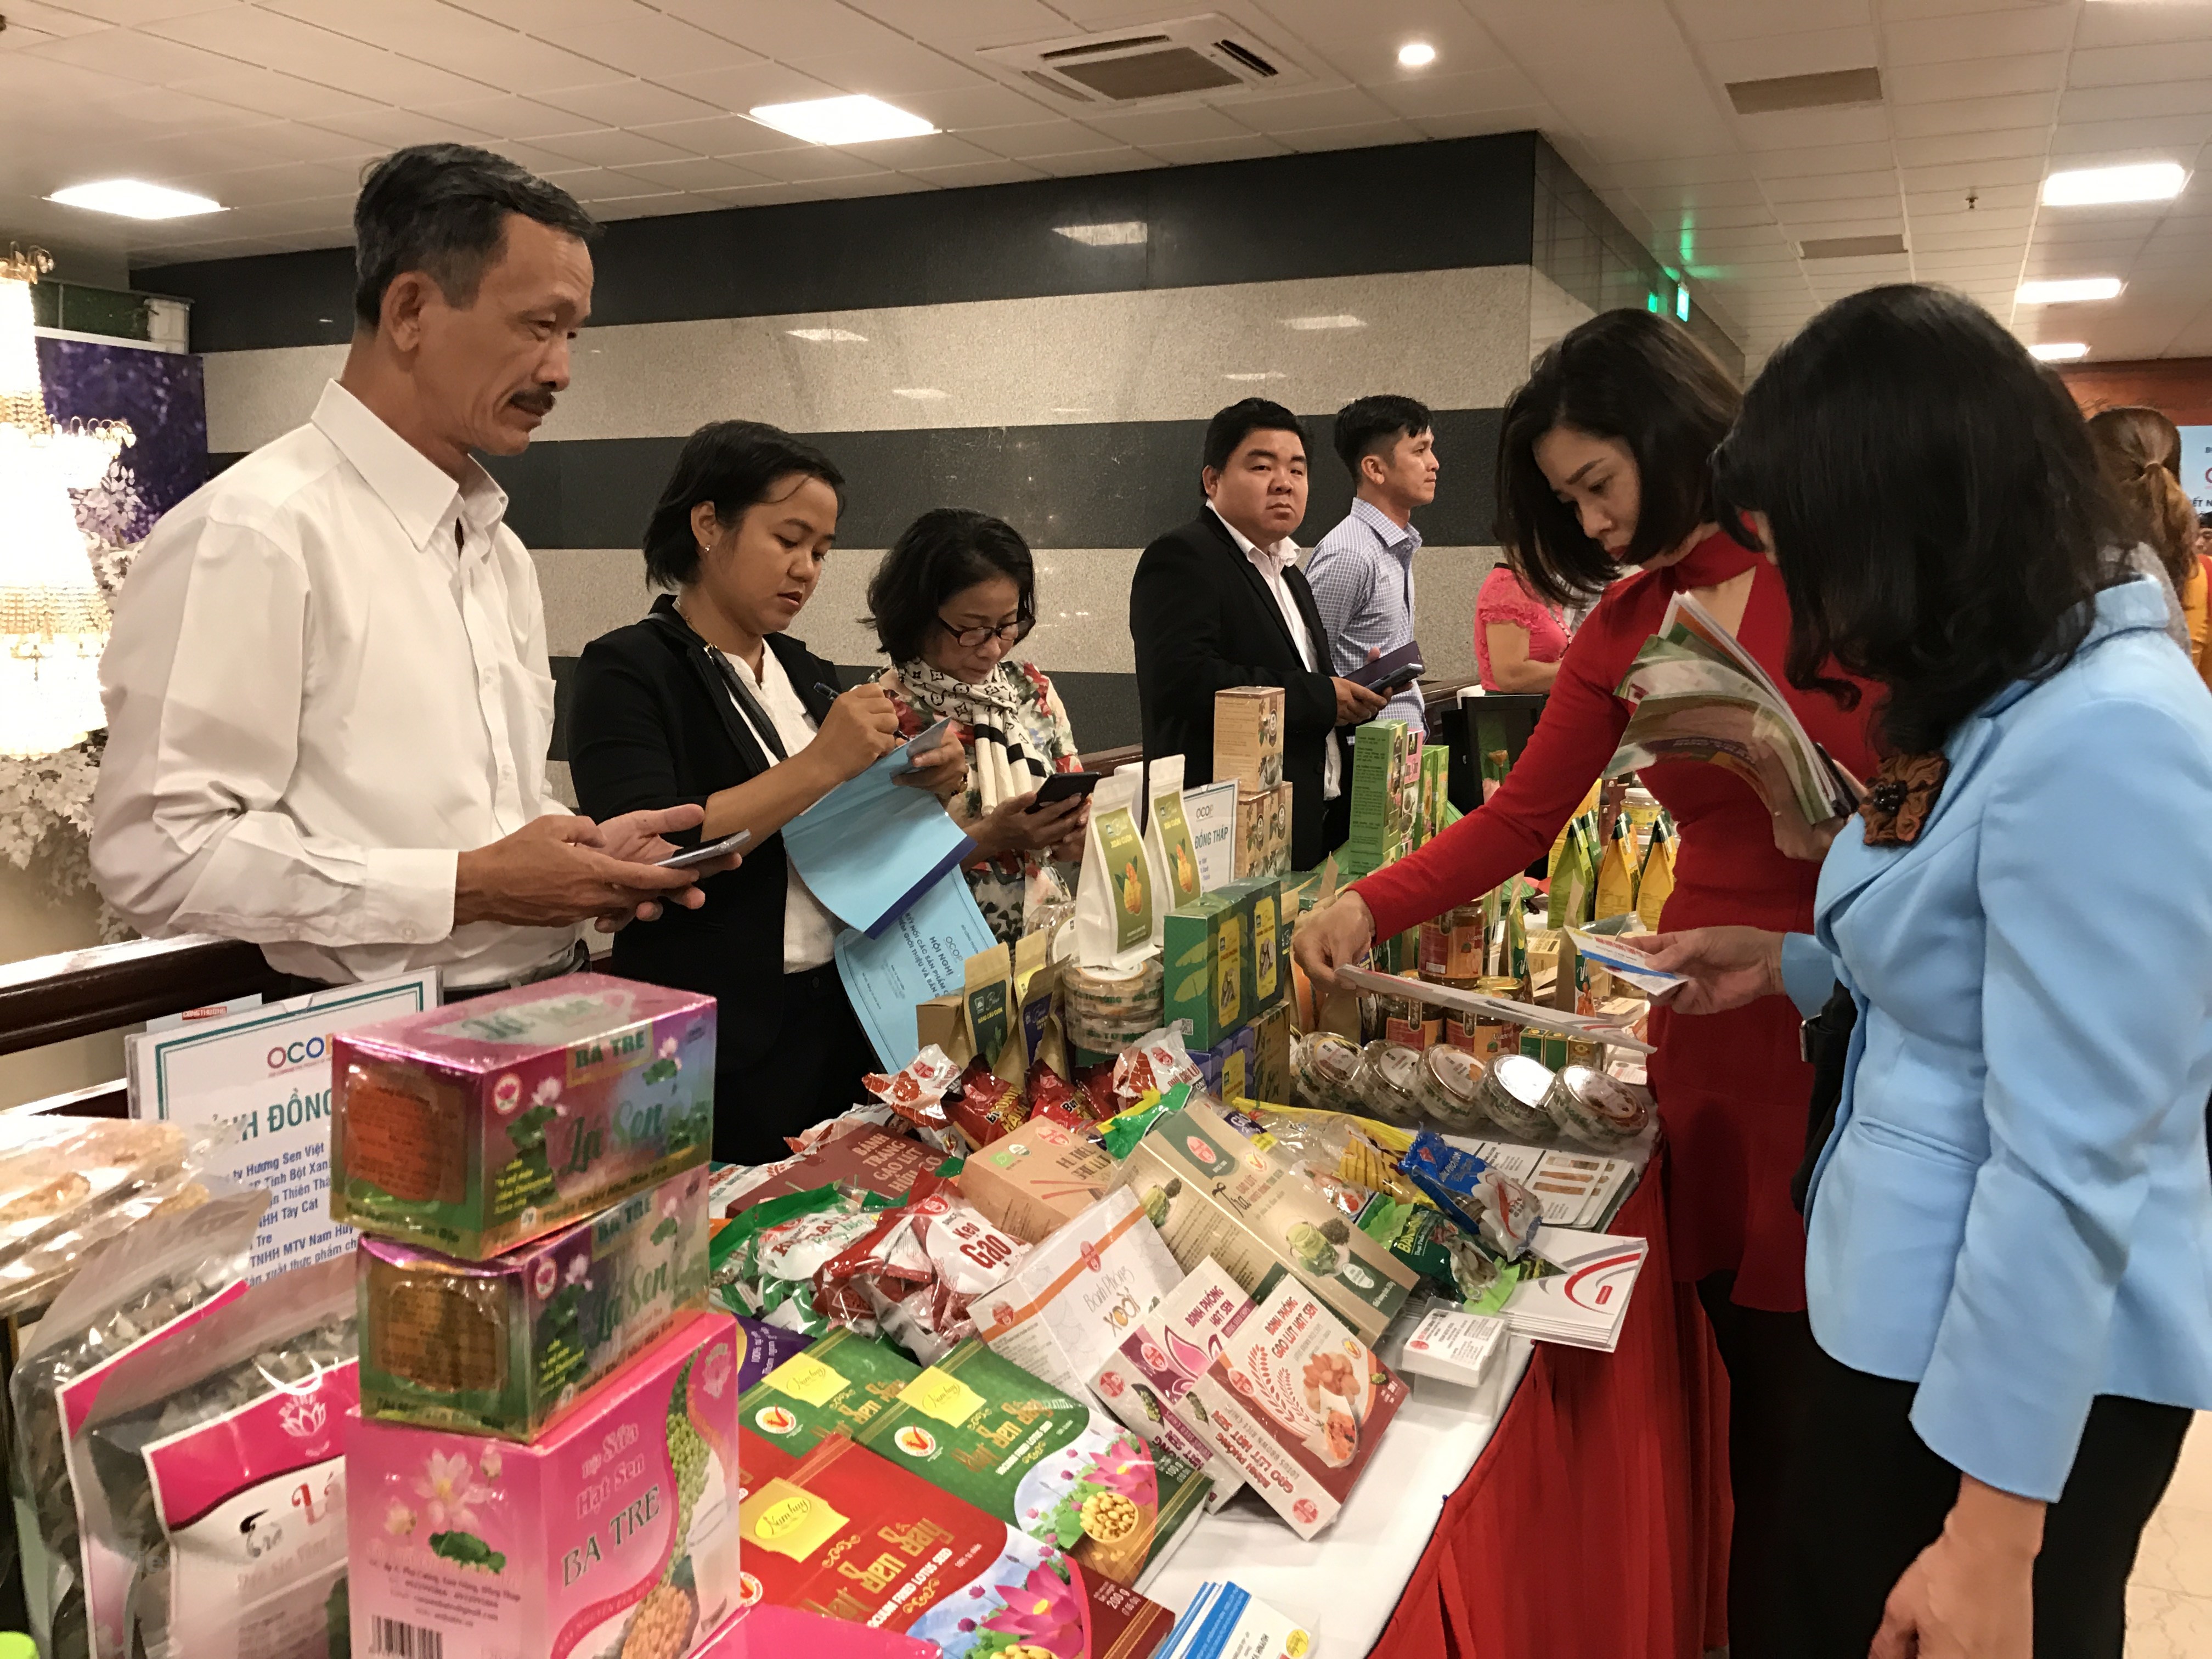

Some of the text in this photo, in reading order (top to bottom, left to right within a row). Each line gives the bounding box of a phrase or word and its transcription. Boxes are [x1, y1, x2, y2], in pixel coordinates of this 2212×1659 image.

[2191, 496, 2204, 507] ẾT
[1196, 804, 1214, 819] OCOP
[1194, 826, 1228, 849] ĐỒNG THÁP
[910, 924, 921, 939] NỐI
[917, 939, 928, 955] CÁC
[925, 955, 936, 969] SẢN
[932, 969, 946, 990] PHẨM
[929, 935, 954, 977] HỘI NGHỊ
[945, 936, 963, 961] OCOP
[904, 933, 915, 949] GIỚI
[911, 947, 924, 967] THIỆU
[921, 967, 930, 979] VÀ
[926, 979, 938, 993] BÁN
[610, 1030, 645, 1056] TRE
[612, 1099, 663, 1144] Sen
[851, 1132, 891, 1156] BÁNH
[862, 1140, 907, 1167] TRÁNG
[246, 1158, 279, 1177] Hương
[283, 1150, 302, 1165] Sen
[304, 1142, 325, 1158] Việt
[290, 1165, 306, 1181] Bột
[282, 1184, 310, 1201] Thiên
[302, 1198, 318, 1213] Cát
[256, 1234, 273, 1248] Tre
[952, 1222, 980, 1240] Kẹo
[250, 1224, 354, 1268] TNHH MTV Nam Huy
[960, 1234, 1012, 1269] Gạo
[1184, 1304, 1205, 1329] BÁNH
[1220, 1299, 1235, 1316] SEN
[1264, 1296, 1299, 1336] BÁNH PHỒNG
[1302, 1301, 1318, 1319] SEN
[1211, 1409, 1233, 1432] SEN
[1243, 1423, 1257, 1438] RICE
[975, 1420, 1023, 1449] Sen
[1257, 1438, 1282, 1462] BROWN
[1245, 1463, 1271, 1489] BÁNH
[1279, 1459, 1300, 1480] LOTUS
[577, 1485, 611, 1521] Hạt
[614, 1453, 646, 1493] Sen
[563, 1532, 602, 1588] BA
[609, 1485, 661, 1548] TRE
[837, 1551, 907, 1594] Sen
[877, 1517, 955, 1558] Sấy
[892, 1581, 917, 1605] FRIED
[911, 1561, 939, 1586] LOTUS
[932, 1547, 953, 1567] SEED
[1106, 1593, 1125, 1610] 200
